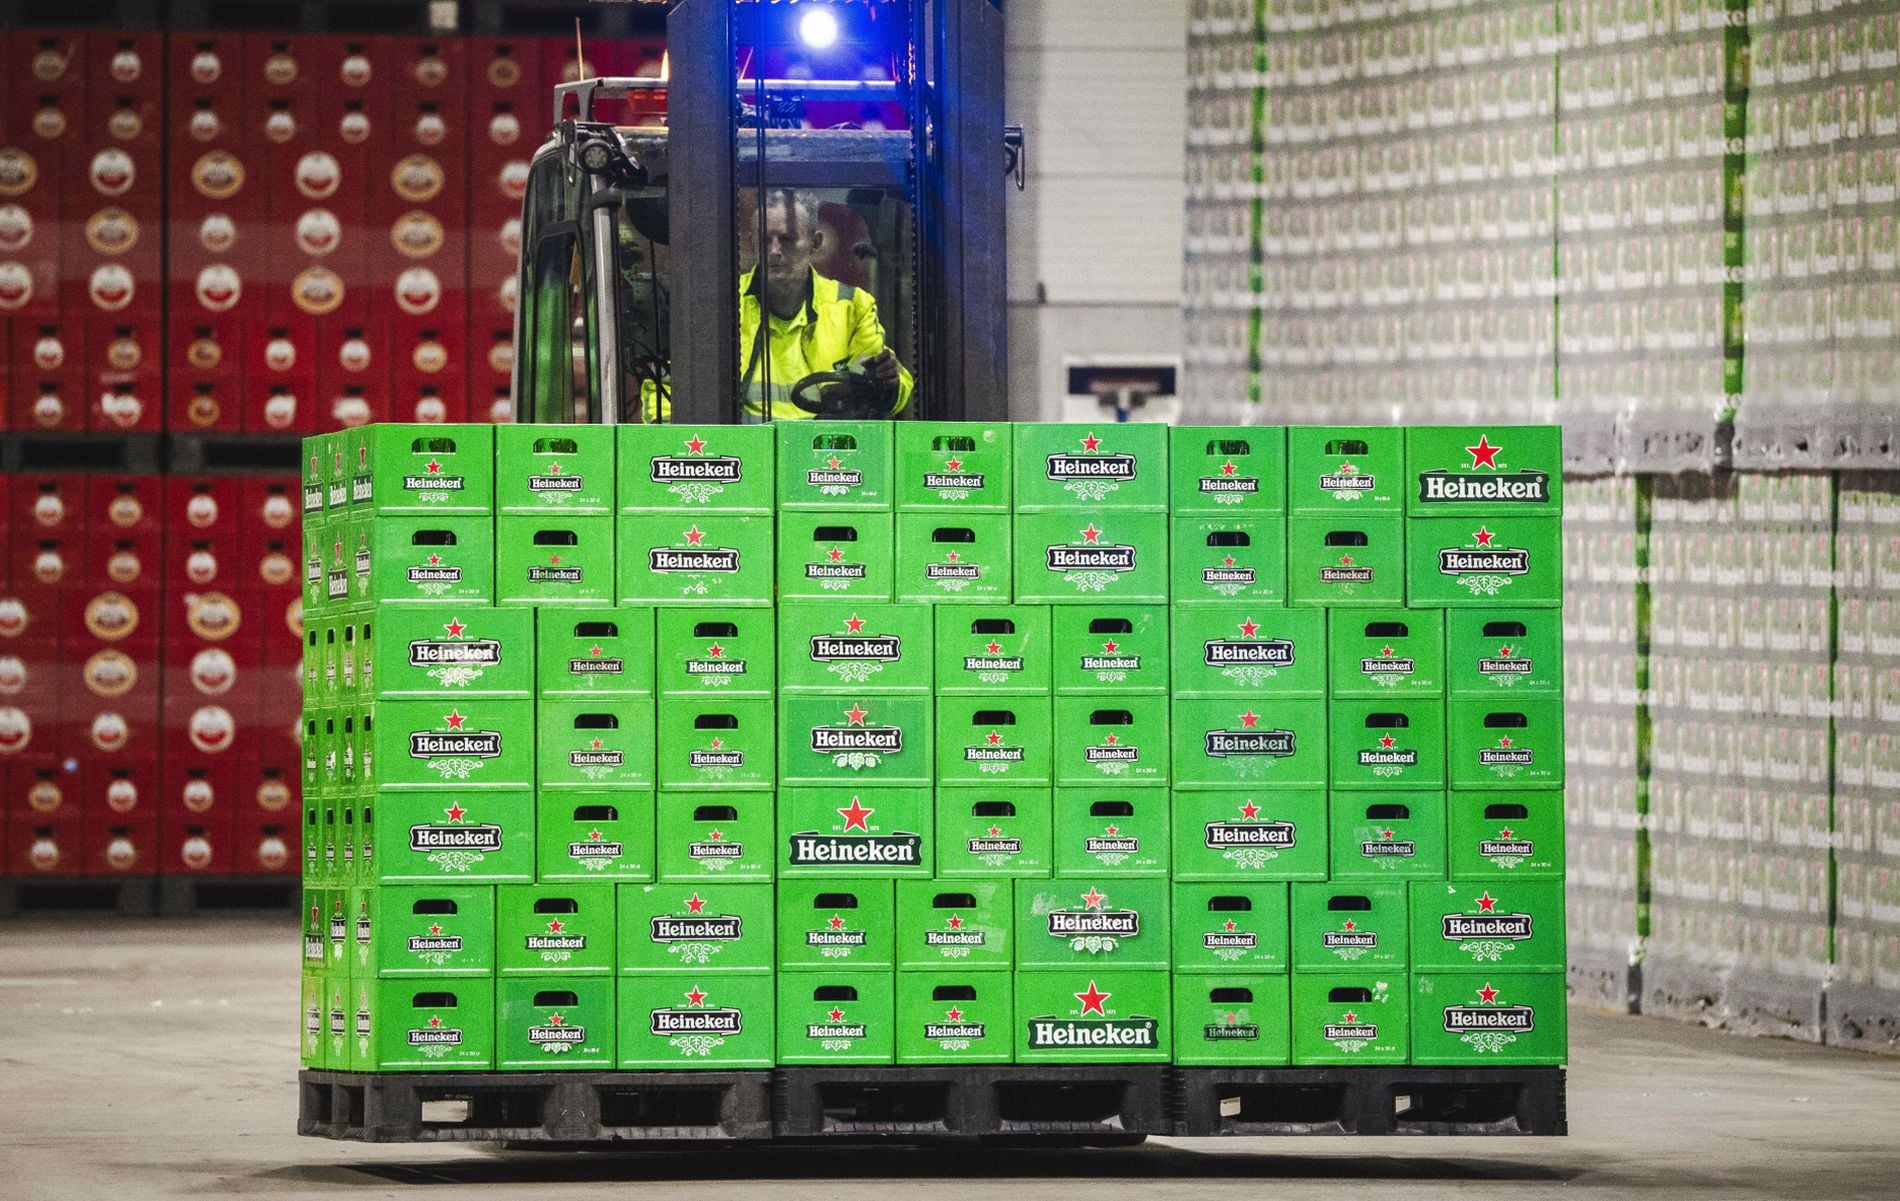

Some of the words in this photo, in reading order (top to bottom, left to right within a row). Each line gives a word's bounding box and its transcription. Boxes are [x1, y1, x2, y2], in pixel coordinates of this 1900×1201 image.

[658, 461, 735, 476] Heineken
[1054, 459, 1130, 473] Heineken
[810, 470, 859, 481] Heineken
[927, 473, 981, 485] Heineken
[407, 476, 460, 487] Heineken
[532, 477, 578, 487] Heineken
[1202, 478, 1256, 489] Heineken
[656, 552, 733, 567] Heineken
[1054, 549, 1130, 564] Heineken
[1446, 553, 1522, 567] Heineken
[411, 568, 458, 578] Heineken
[808, 563, 862, 575] Heineken
[930, 565, 977, 575] Heineken
[1206, 569, 1252, 579] Heineken
[416, 644, 494, 659] Heineken
[818, 639, 894, 654] Heineken
[1211, 644, 1288, 659] Heineken
[689, 660, 744, 672] Heineken
[966, 656, 1021, 668] Heineken
[1084, 655, 1138, 667] Heineken
[1365, 660, 1411, 670] Heineken
[1482, 660, 1528, 670] Heineken
[816, 729, 896, 745] Heineken
[1212, 735, 1289, 750] Heineken
[417, 736, 494, 751] Heineken
[574, 752, 620, 762] Heineken
[694, 752, 740, 762] Heineken
[967, 747, 1021, 758] Heineken
[1089, 747, 1135, 758] Heineken
[1361, 750, 1415, 762] Heineken
[1483, 751, 1529, 761] Heineken
[417, 829, 494, 844] Heineken
[1212, 826, 1288, 841] Heineken
[572, 844, 619, 854] Heineken
[693, 844, 739, 854] Heineken
[972, 840, 1018, 850] Heineken
[1089, 839, 1135, 849] Heineken
[1484, 842, 1530, 852] Heineken
[1052, 913, 1133, 929] Heineken
[1449, 918, 1525, 933] Heineken
[658, 920, 735, 935] Heineken
[412, 937, 459, 947] Heineken
[528, 936, 583, 947] Heineken
[809, 931, 863, 943] Heineken
[928, 931, 983, 943] Heineken
[1207, 934, 1253, 944] Heineken
[1327, 933, 1373, 943] Heineken
[658, 1013, 735, 1028] Heineken
[1451, 1010, 1527, 1025] Heineken
[531, 1027, 581, 1038] Heineken
[809, 1024, 863, 1035] Heineken
[928, 1024, 982, 1035] Heineken
[1327, 1026, 1374, 1036] Heineken
[412, 1031, 458, 1041] Heineken
